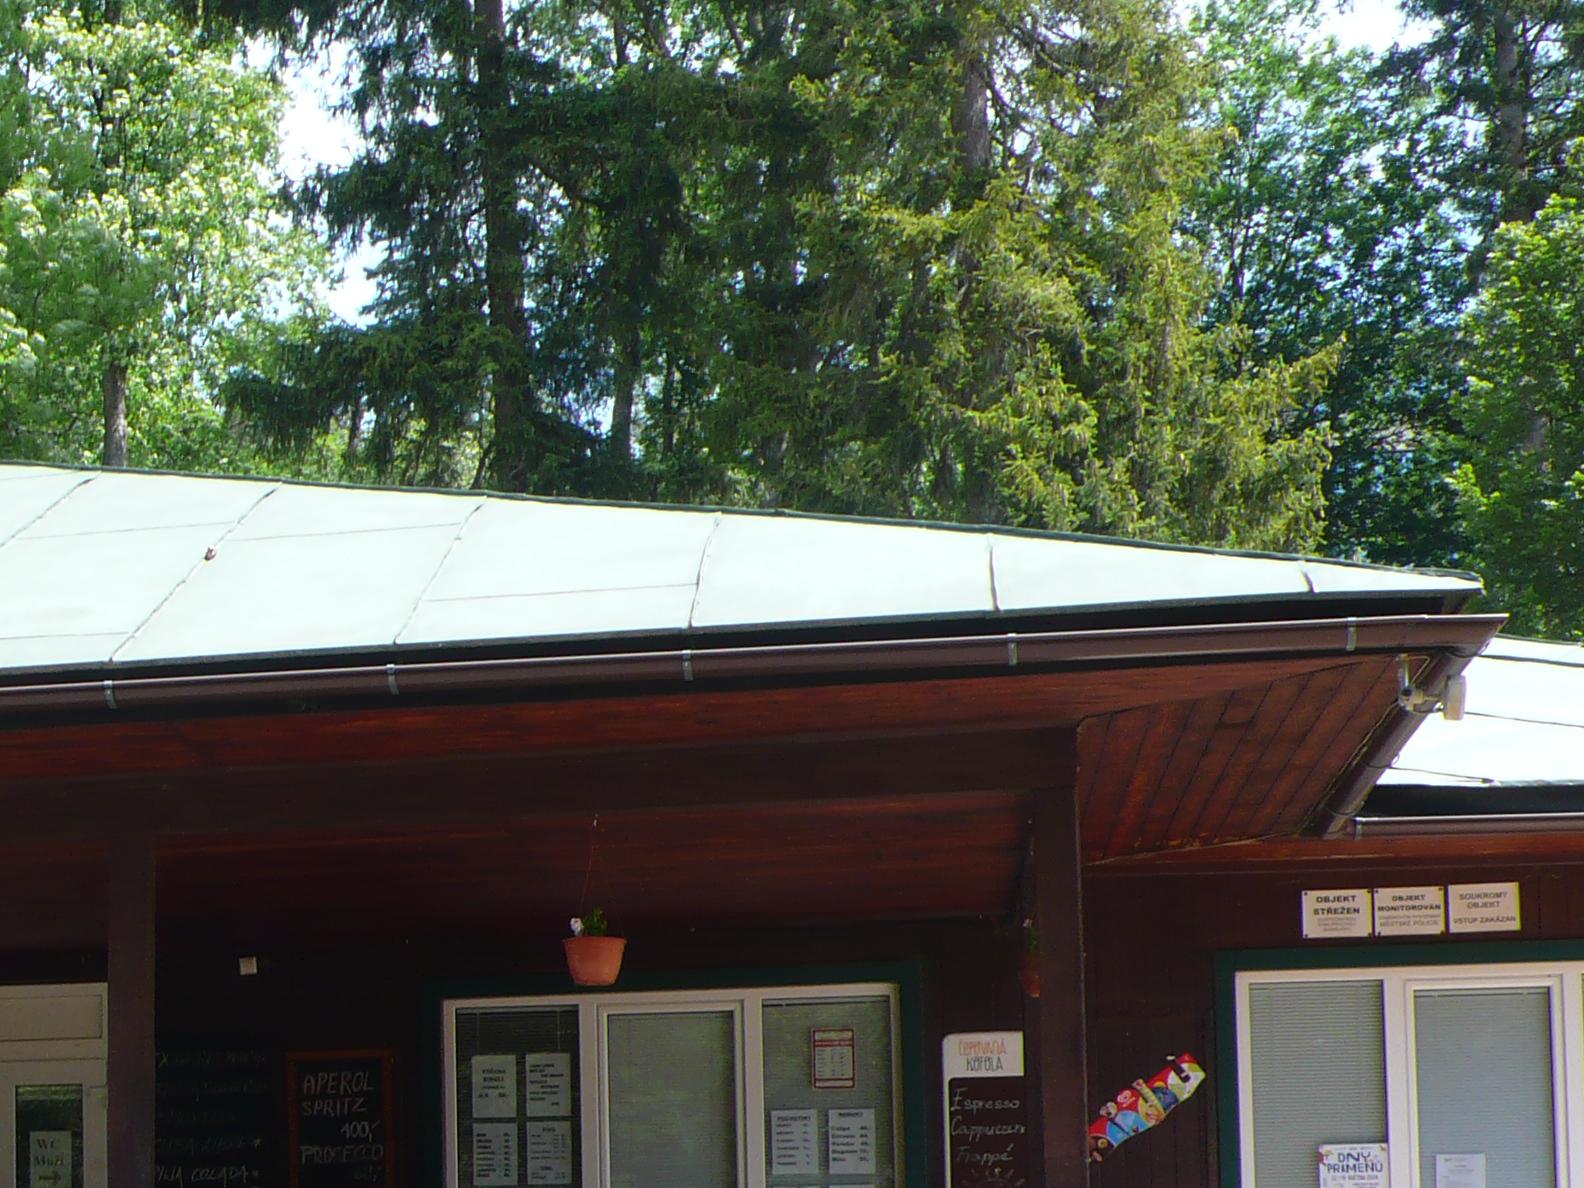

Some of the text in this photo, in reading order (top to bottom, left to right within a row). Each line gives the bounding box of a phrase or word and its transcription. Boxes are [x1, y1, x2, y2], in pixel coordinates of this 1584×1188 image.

[1316, 895, 1357, 904] OBJEKT
[1392, 894, 1426, 902] OBJEKT
[1313, 905, 1361, 916] STŘEŽEN
[1466, 901, 1500, 909] OBJEKT
[303, 1071, 376, 1096] APEROL
[302, 1096, 369, 1118] SPRITZ
[950, 1087, 1022, 1116] Espresso
[1337, 1151, 1371, 1163] DNY
